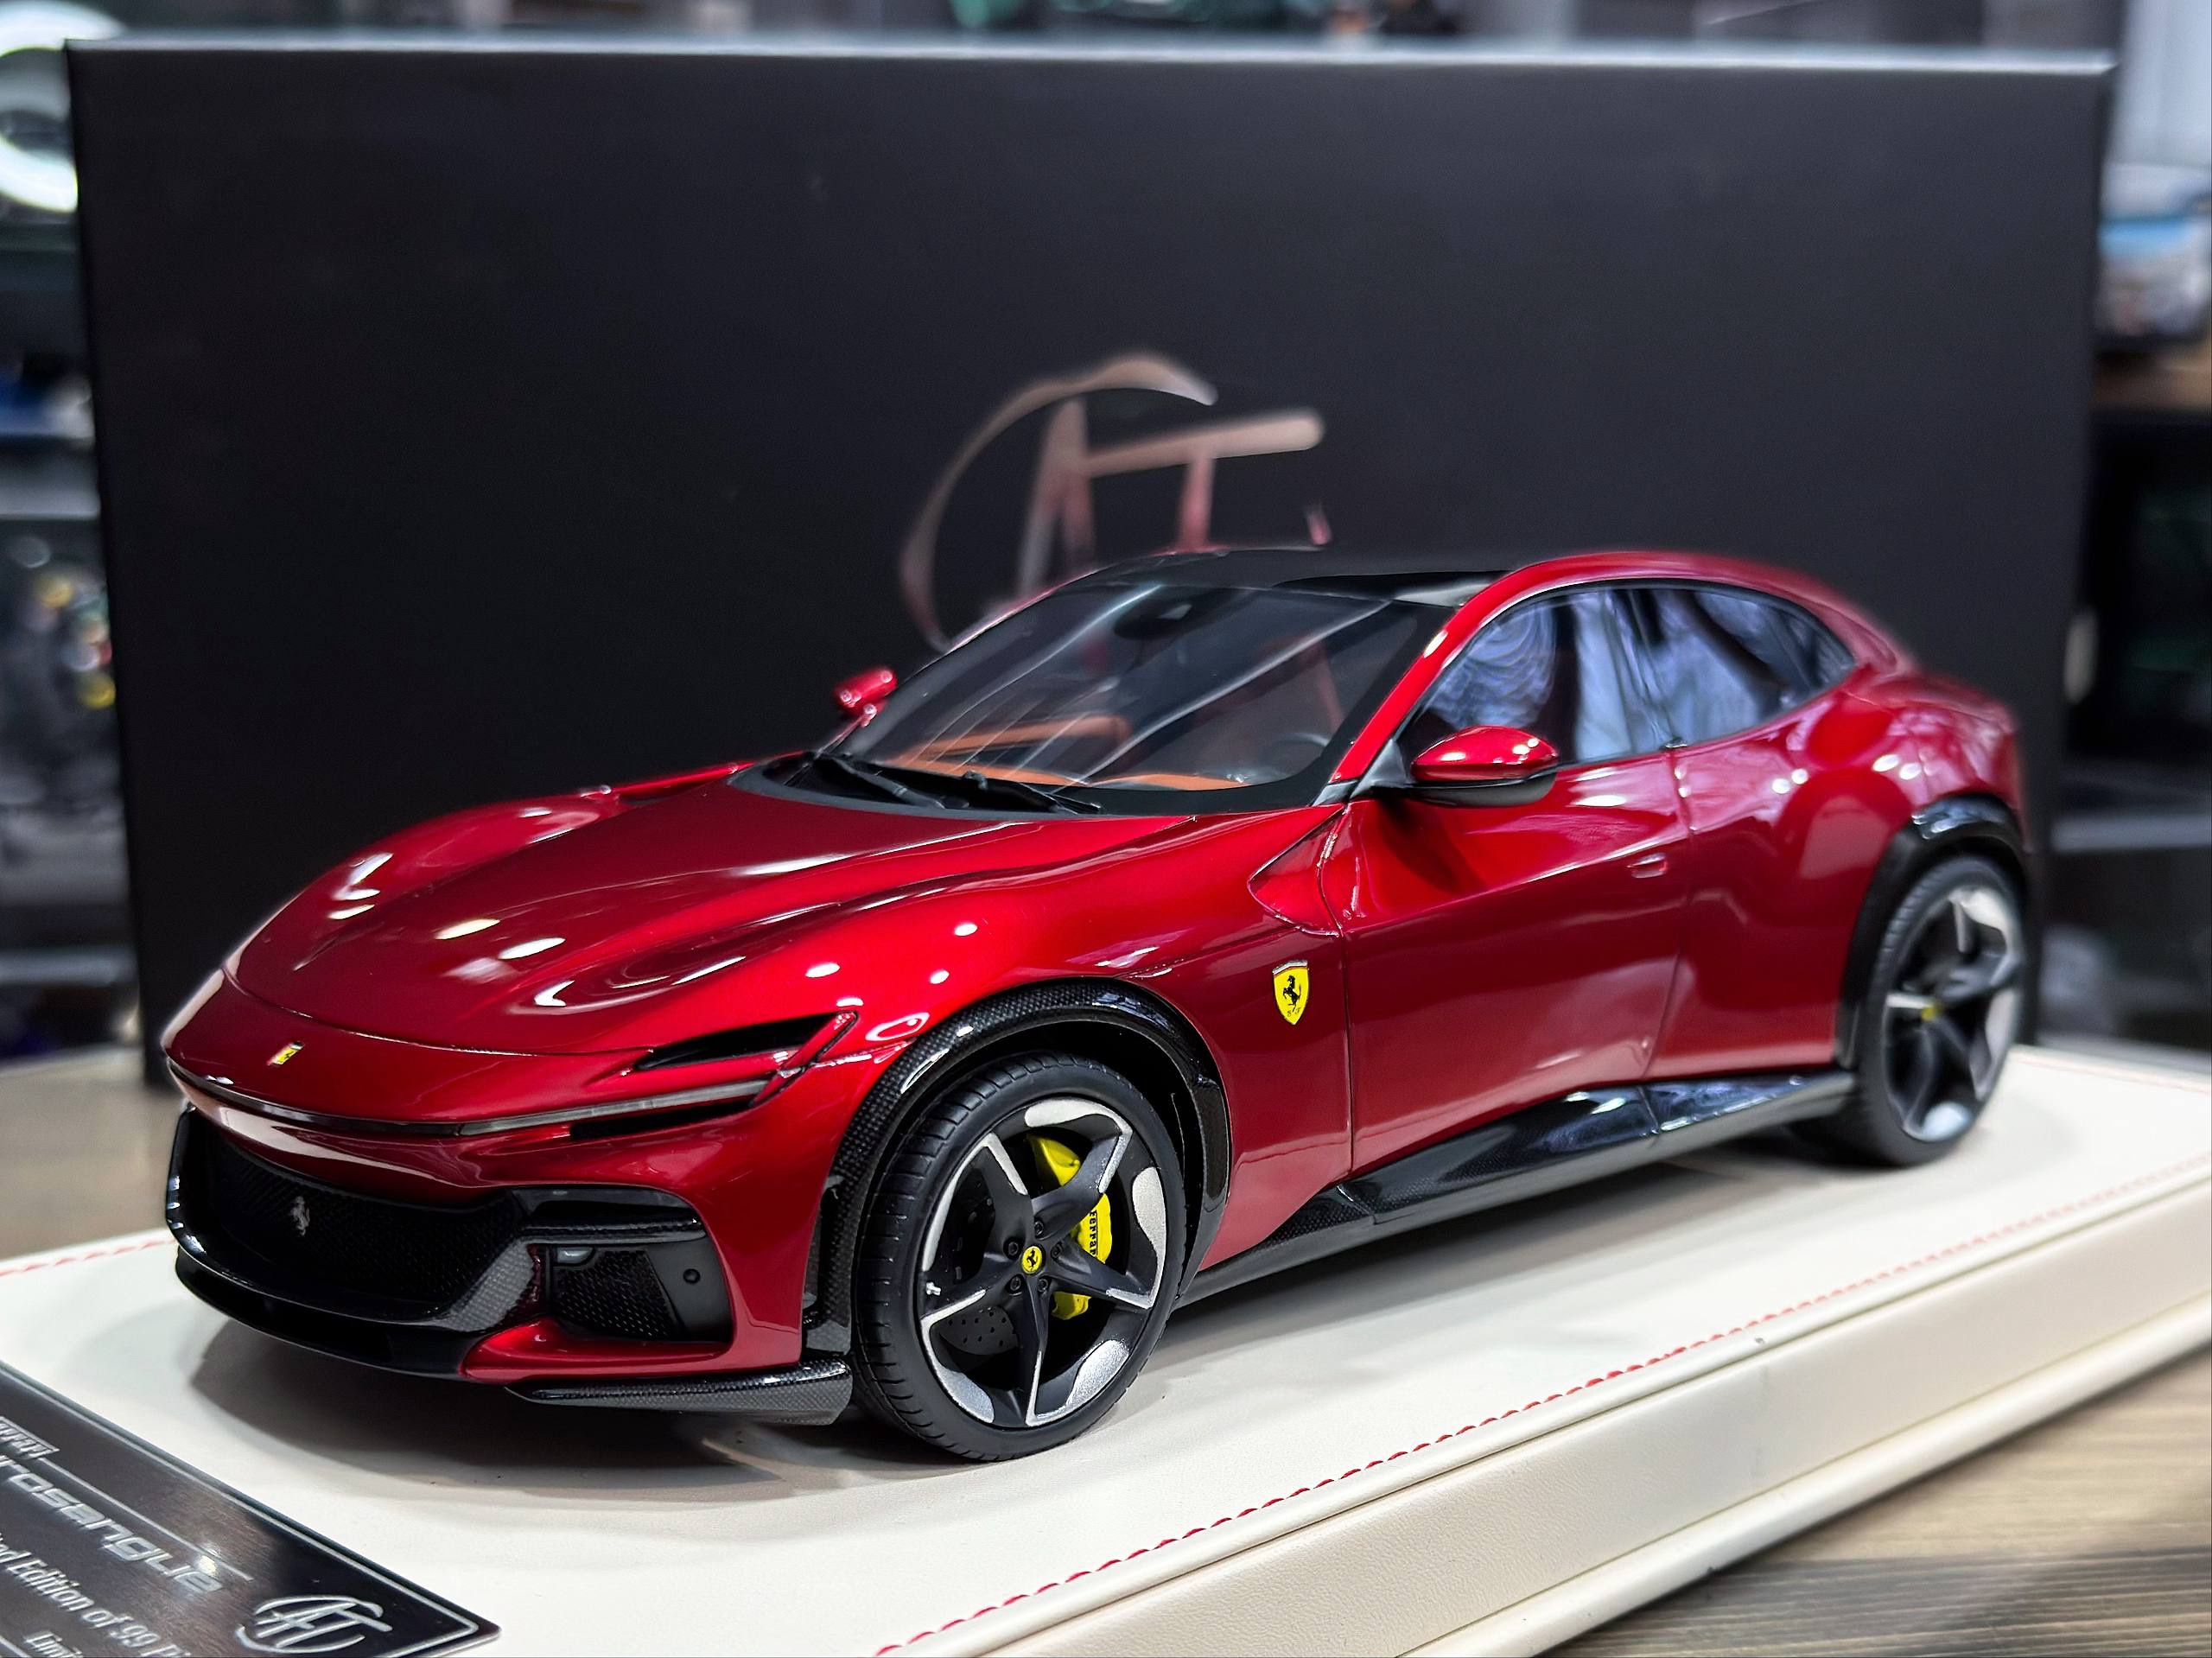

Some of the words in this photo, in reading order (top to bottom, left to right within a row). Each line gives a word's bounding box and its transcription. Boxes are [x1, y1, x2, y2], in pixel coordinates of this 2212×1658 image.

[1089, 1210, 1098, 1256] Ferrar
[0, 1455, 222, 1594] rosangue
[7, 1559, 94, 1611] Edition
[81, 1609, 134, 1629] of
[108, 1624, 162, 1648] 99
